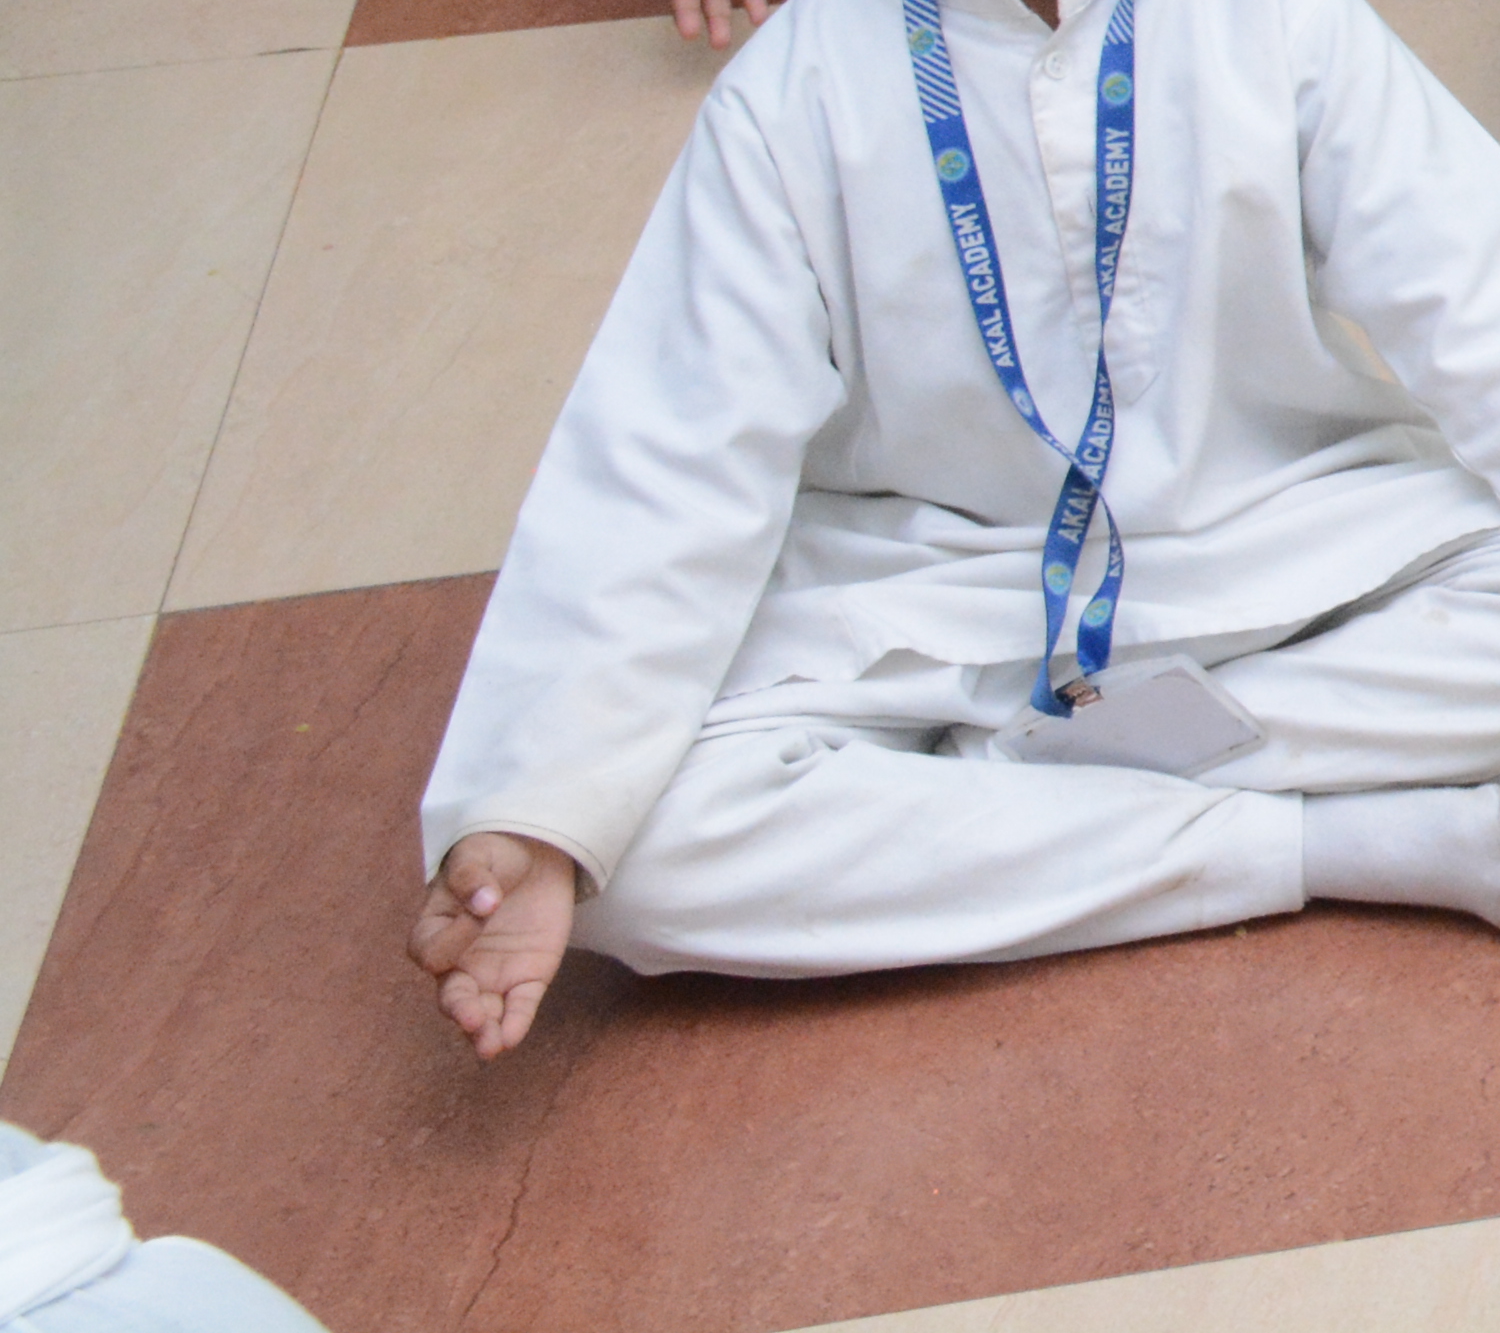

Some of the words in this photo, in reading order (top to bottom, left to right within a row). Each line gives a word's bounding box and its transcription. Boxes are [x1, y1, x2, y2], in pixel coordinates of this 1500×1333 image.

[1104, 127, 1131, 236] ACADEMY
[949, 200, 998, 306] ACADEMY
[1099, 242, 1121, 298] AKAL
[981, 309, 1016, 369] AKAL
